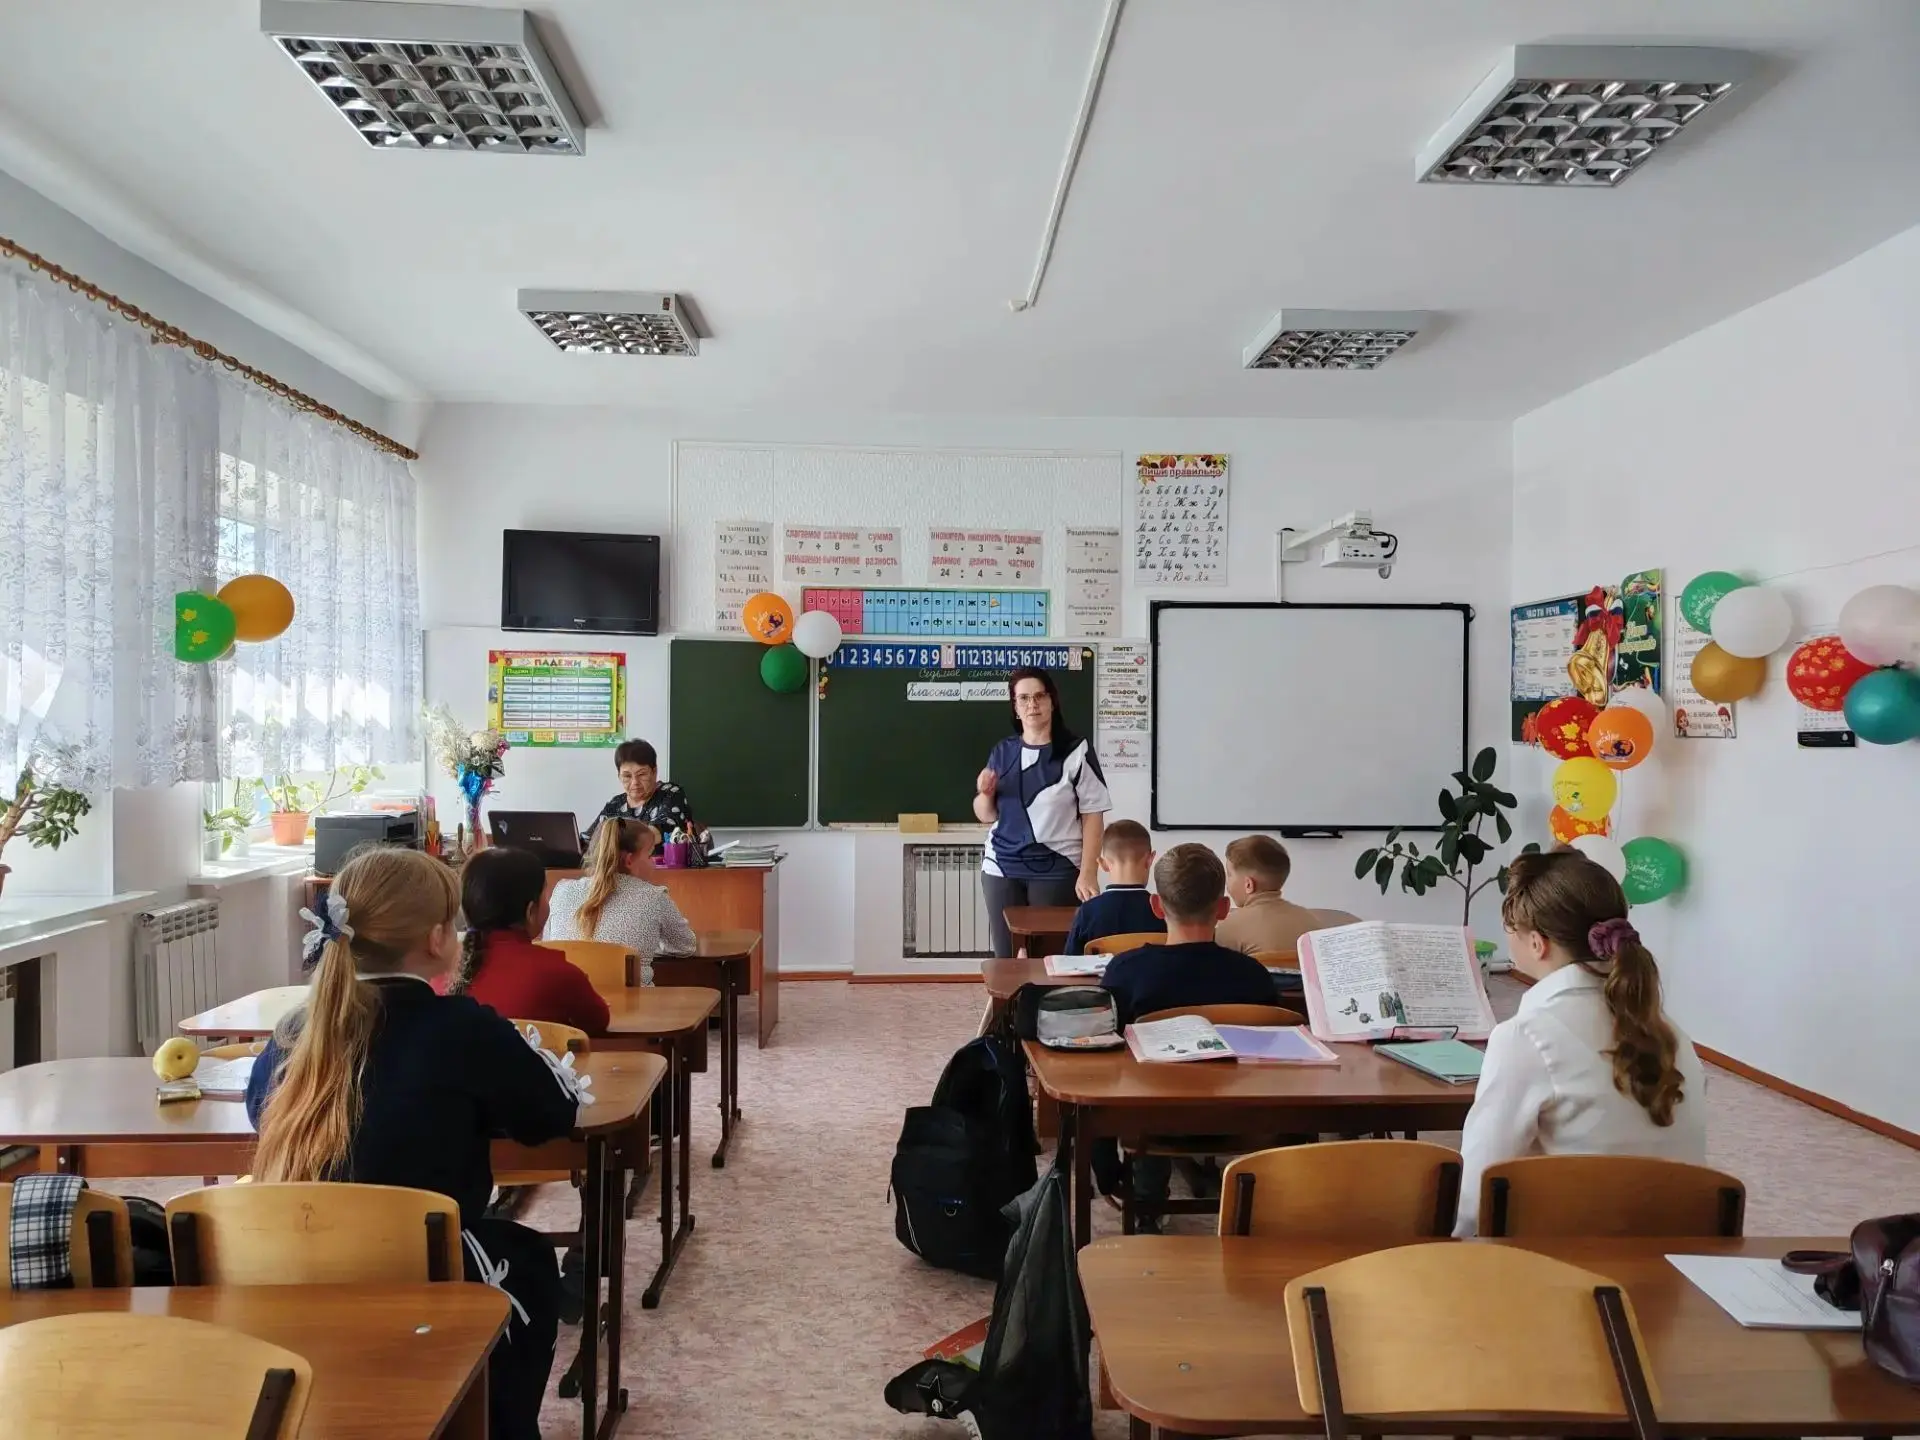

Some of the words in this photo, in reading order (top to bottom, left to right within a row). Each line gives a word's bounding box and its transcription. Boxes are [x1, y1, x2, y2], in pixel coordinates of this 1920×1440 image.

[720, 535, 736, 544] ЧУ
[748, 535, 769, 545] ЩУ
[868, 533, 893, 542] сумма
[798, 541, 804, 550] 7
[834, 542, 840, 550] 8
[978, 544, 983, 552] 3
[1016, 546, 1024, 554] 24
[866, 557, 898, 567] разность
[1008, 559, 1035, 568] частное
[796, 567, 806, 575] 16
[834, 568, 840, 576] 7
[876, 569, 882, 577] 9
[940, 568, 950, 576] 24
[720, 573, 736, 582] ЧА
[748, 574, 768, 583] ЩА
[832, 598, 837, 606] у
[900, 599, 906, 607] р
[933, 618, 942, 627] ф
[1003, 620, 1009, 628] ц
[534, 659, 581, 667] ПАДЕЖИ
[826, 652, 833, 664] 0
[839, 649, 845, 664] 1
[850, 649, 857, 664] 2
[862, 649, 869, 664] 3
[873, 649, 881, 664] 4
[885, 649, 892, 664] 5
[896, 649, 904, 664] 6
[908, 649, 916, 664] 7
[920, 649, 928, 664] 8
[932, 649, 940, 664] 9
[944, 649, 953, 664] 10
[956, 649, 966, 665] 11
[968, 650, 979, 665] 12
[981, 650, 992, 665] 13
[994, 650, 1005, 665] 14
[1007, 650, 1018, 666] 15
[1020, 650, 1030, 666] 16
[1032, 650, 1042, 666] 17
[1044, 651, 1055, 666] 18
[1058, 651, 1068, 667] 19
[1070, 651, 1080, 667] 20
[908, 683, 960, 698] Классная
